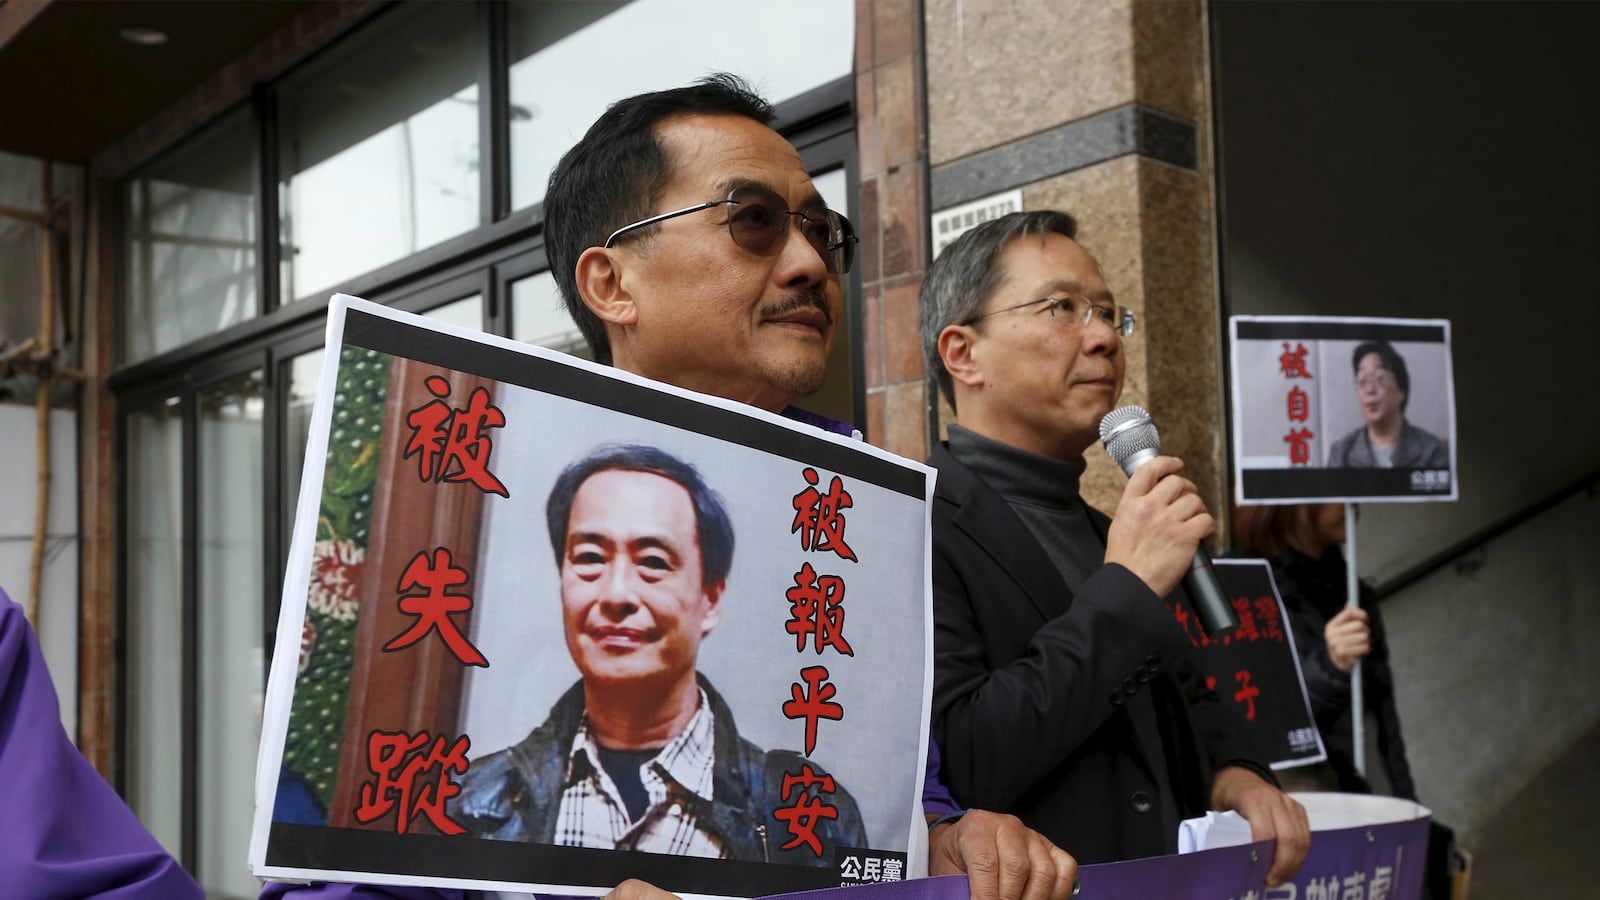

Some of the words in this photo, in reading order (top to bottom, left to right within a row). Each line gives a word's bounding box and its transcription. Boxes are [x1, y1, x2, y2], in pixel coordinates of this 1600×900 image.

[1279, 342, 1314, 464] 被自首
[354, 375, 510, 835] 被失蹤
[773, 467, 858, 857] 被報平安
[840, 856, 902, 882] 公民黨
